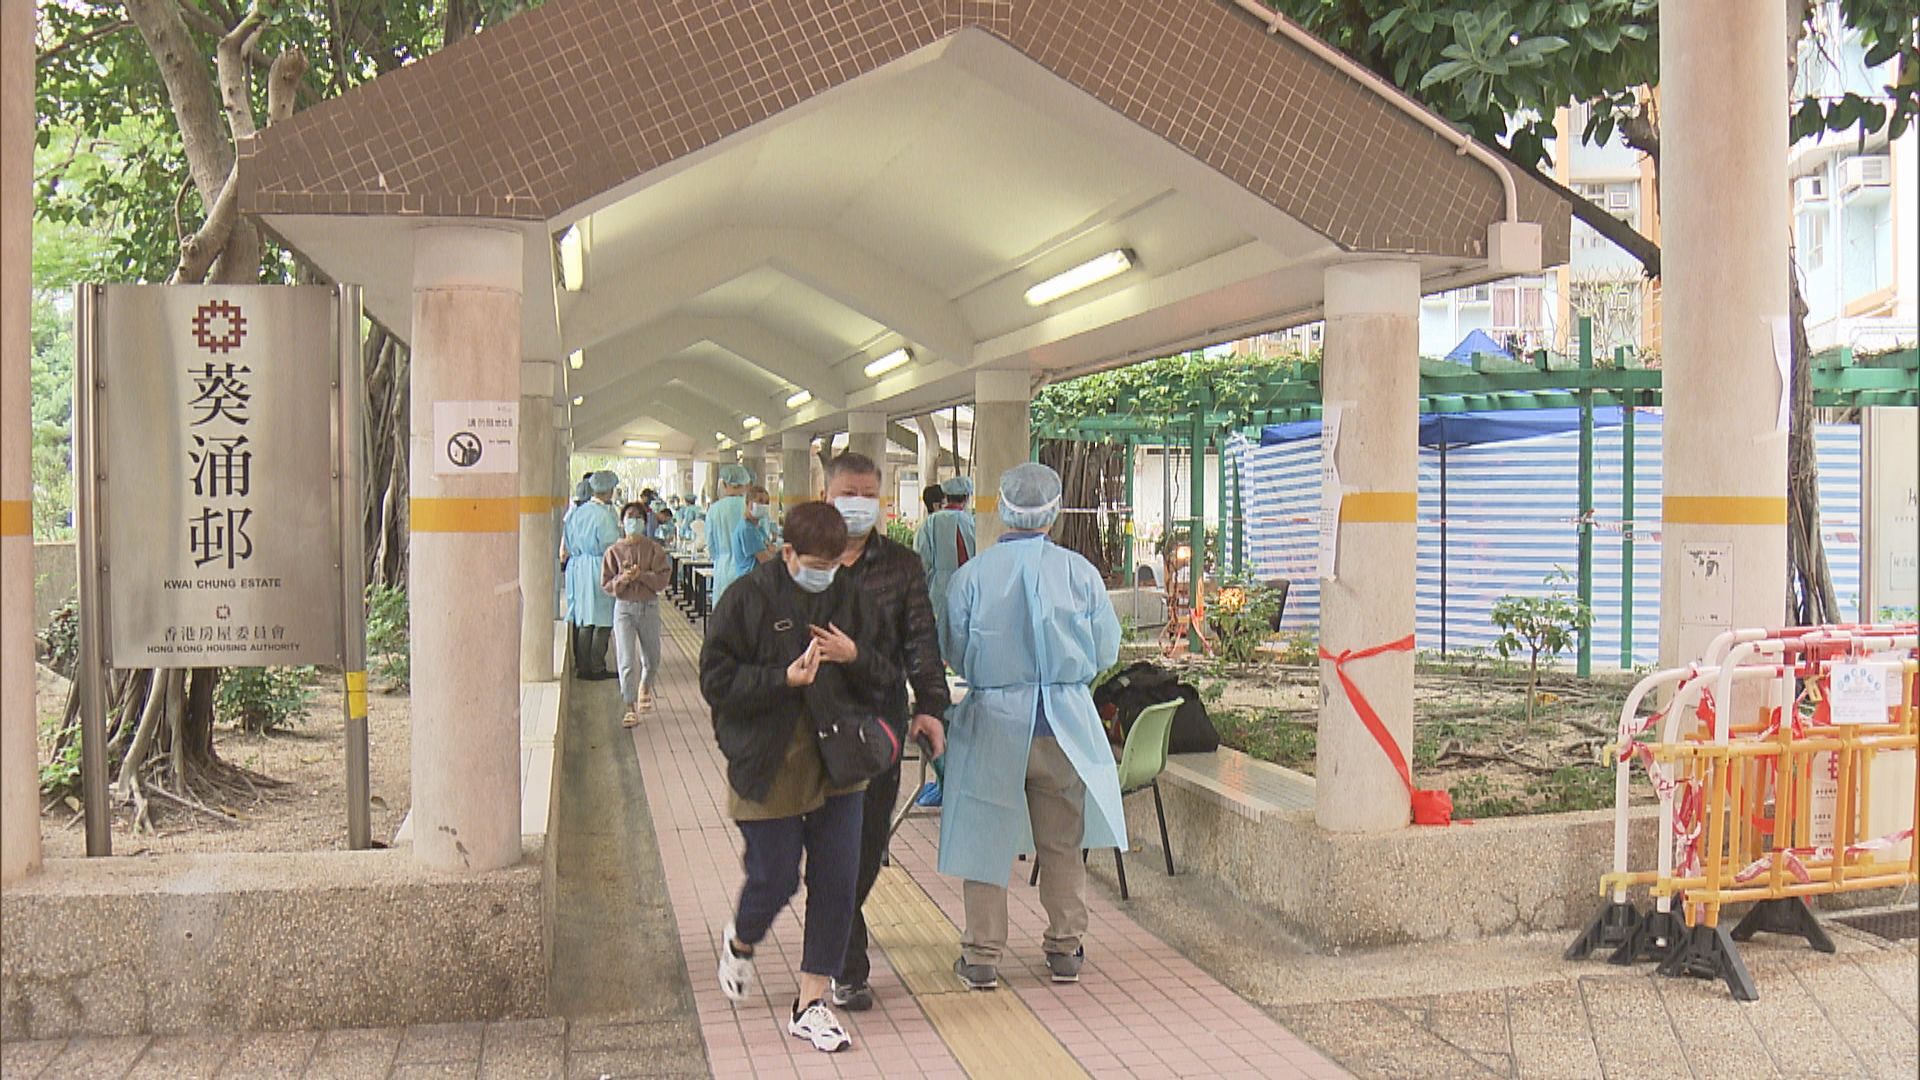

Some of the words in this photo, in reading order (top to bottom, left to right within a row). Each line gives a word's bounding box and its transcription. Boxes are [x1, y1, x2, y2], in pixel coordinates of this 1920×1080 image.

[187, 362, 253, 570] 葵涌邨
[163, 579, 193, 590] KWAI
[196, 579, 236, 589] CHUNG
[240, 578, 281, 588] ESTATE
[165, 624, 285, 642] 香港房屋委員會
[147, 645, 174, 654] HONG
[176, 645, 203, 653] KONG
[206, 644, 247, 652] HOUSING
[250, 642, 300, 652] AUTHORITY
